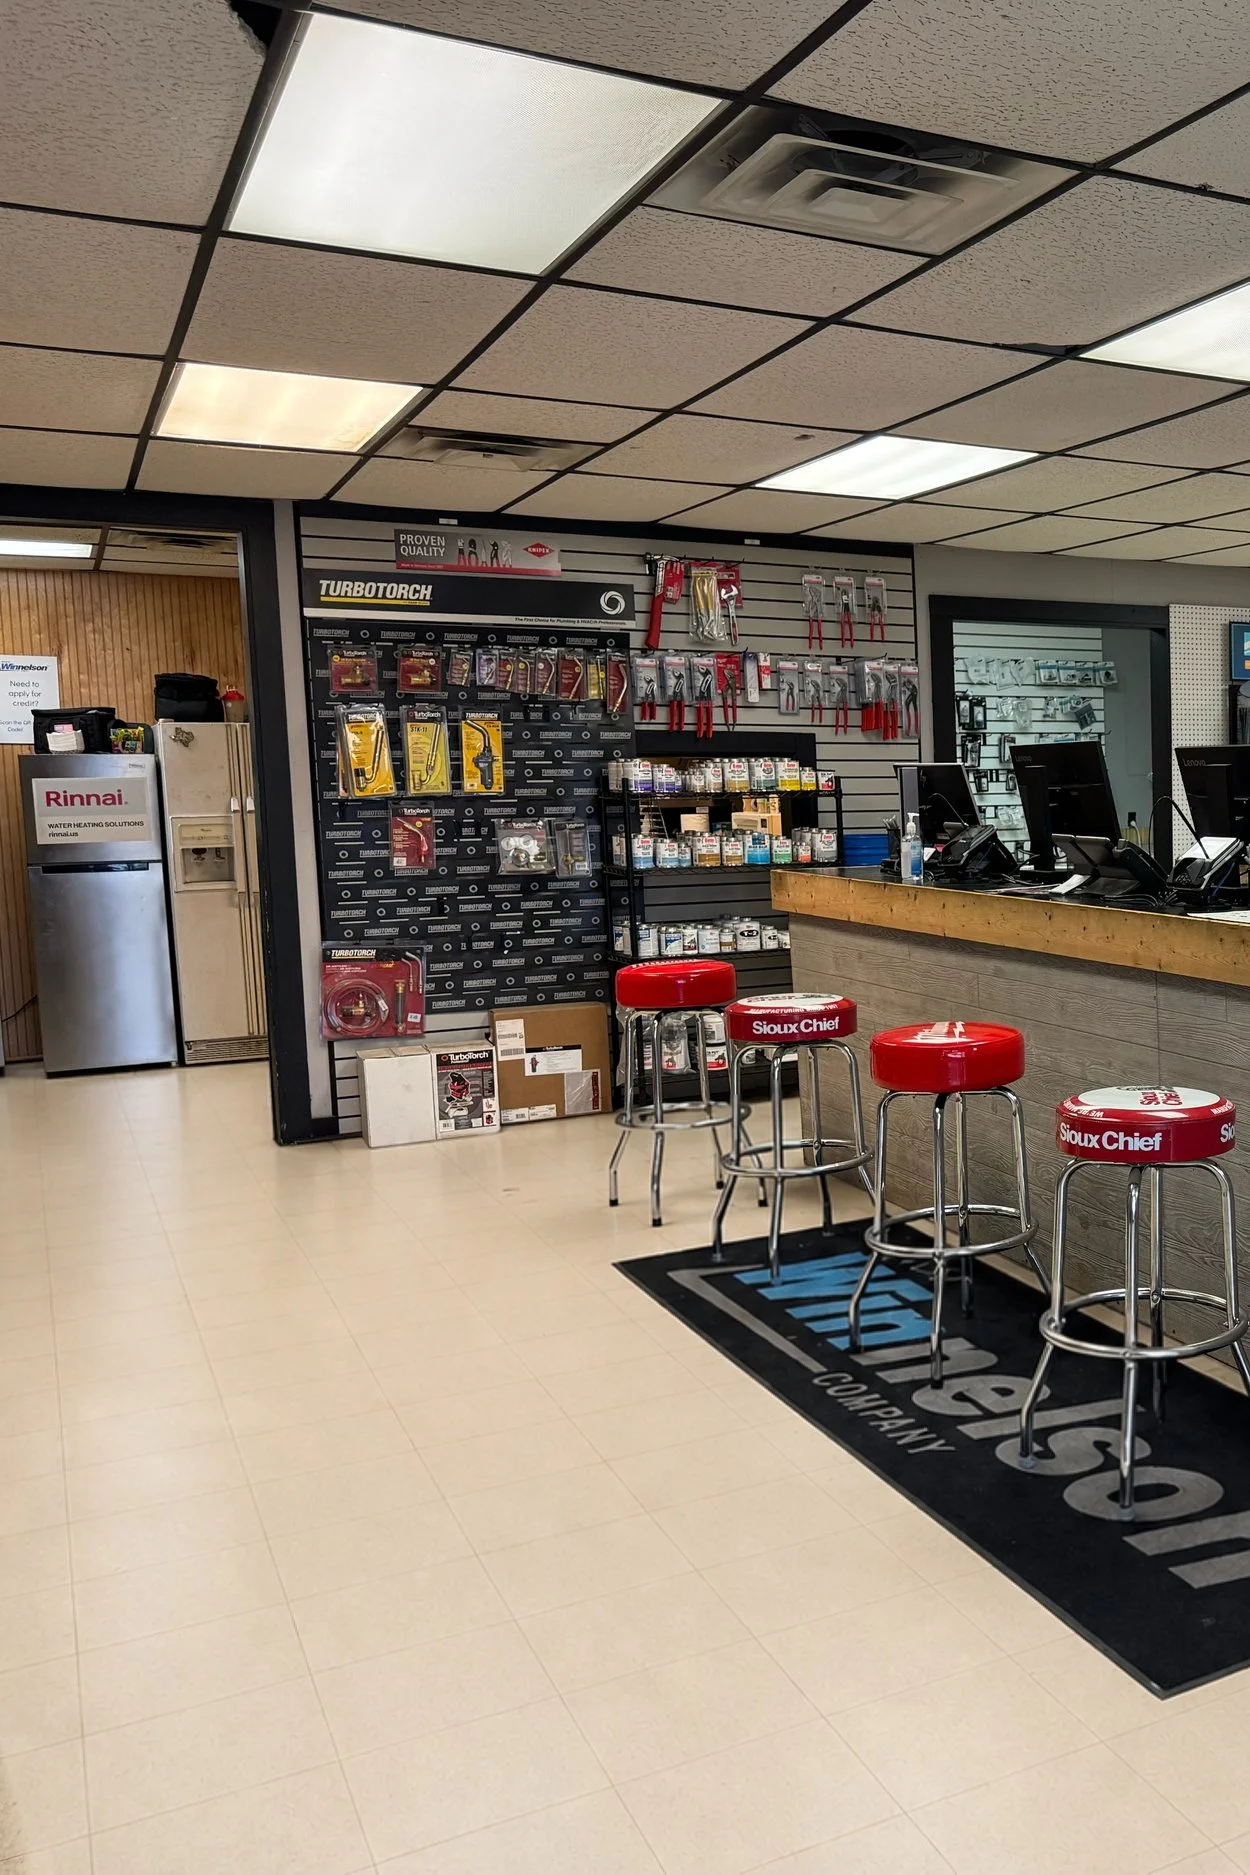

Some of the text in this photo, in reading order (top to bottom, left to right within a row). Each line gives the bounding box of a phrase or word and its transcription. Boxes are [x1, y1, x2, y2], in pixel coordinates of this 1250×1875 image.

[400, 534, 445, 546] PROVEN
[400, 546, 445, 557] QUALITY
[320, 580, 432, 600] TURBOTORCH
[1, 663, 48, 672] Winnelson
[8, 690, 30, 698] apply
[414, 711, 440, 719] TurboTorch
[1182, 758, 1206, 767] Lenovo
[45, 789, 123, 807] Rinnai
[104, 820, 144, 828] SOLUTIONS
[331, 949, 376, 959] TURBOTORCH
[752, 1016, 839, 1035] Sioux Chief
[448, 1052, 488, 1061] TurboTorch
[1059, 1122, 1163, 1151] Sioux Chief
[811, 1371, 956, 1455] COMPANY
